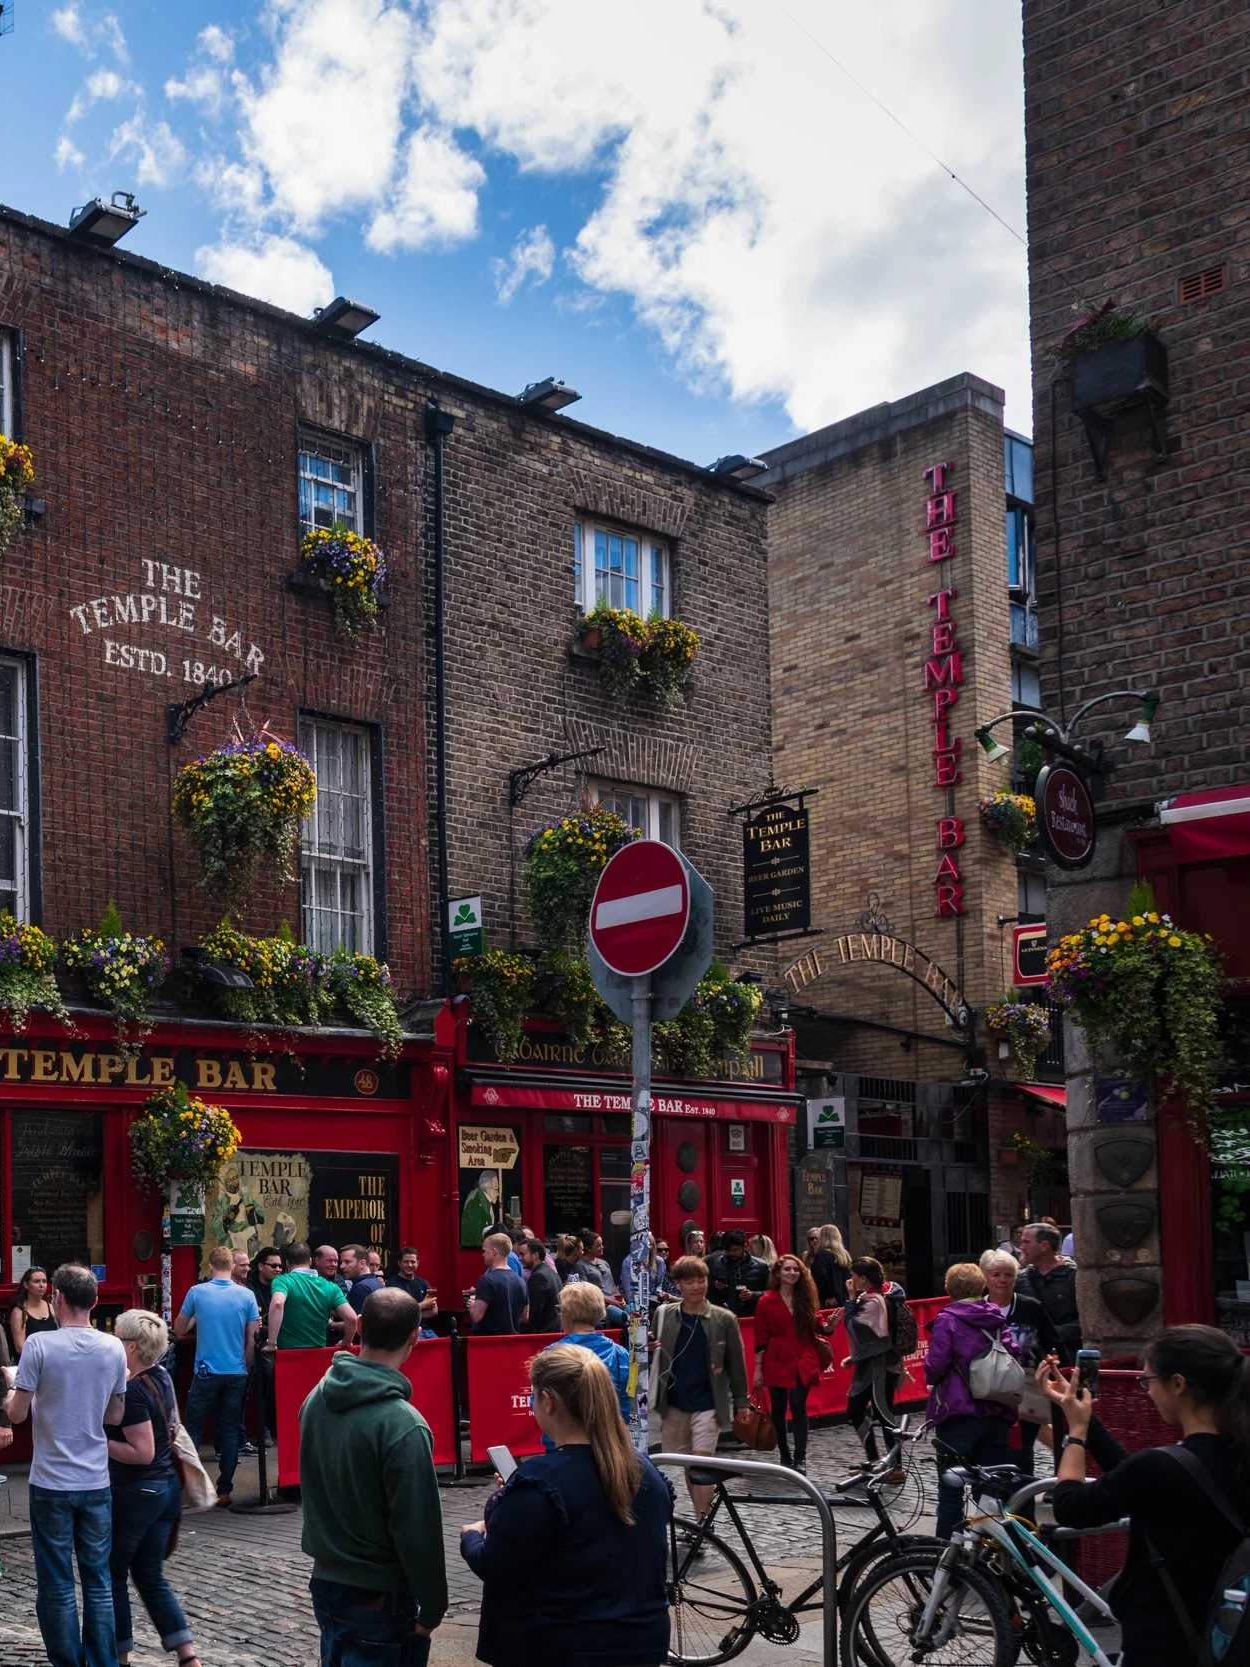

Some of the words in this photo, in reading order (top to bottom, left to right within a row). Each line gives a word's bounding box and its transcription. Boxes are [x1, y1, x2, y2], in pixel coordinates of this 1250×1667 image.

[922, 461, 958, 563] THE
[141, 557, 201, 600] THE
[69, 593, 196, 635] TEMPLE
[206, 614, 265, 677] BAR
[103, 638, 172, 678] ESTD.
[182, 660, 233, 688] 1840
[924, 588, 964, 790] TEMPLE
[766, 811, 786, 822] THE
[746, 818, 807, 841] TEMPLE
[760, 837, 794, 853] BAR
[748, 872, 770, 883] BEER
[770, 866, 806, 879] GARDEN
[934, 815, 967, 919] BAR
[750, 906, 772, 916] LIVE
[773, 900, 804, 912] MUSIC
[762, 913, 791, 925] DAILY
[784, 949, 830, 994] THE
[833, 933, 916, 971] TEMPLE
[924, 960, 963, 1016] BAR
[196, 1068, 277, 1091] BAR
[356, 1071, 374, 1091] 48
[574, 1093, 602, 1109] THE
[603, 1095, 656, 1112] TEME
[659, 1097, 684, 1113] BAR
[702, 1105, 717, 1115] 1840
[461, 1128, 479, 1142] Beer
[480, 1130, 508, 1143] Garden
[461, 1142, 494, 1157] Smoking
[235, 1160, 308, 1179] TEMPLE
[468, 1155, 486, 1167] Area
[358, 1175, 386, 1197] THE
[802, 1169, 827, 1183] TEMPLE
[258, 1178, 293, 1197] BAR
[807, 1182, 824, 1196] BAR
[324, 1198, 386, 1220] EMPEROR
[370, 1223, 386, 1244] OF
